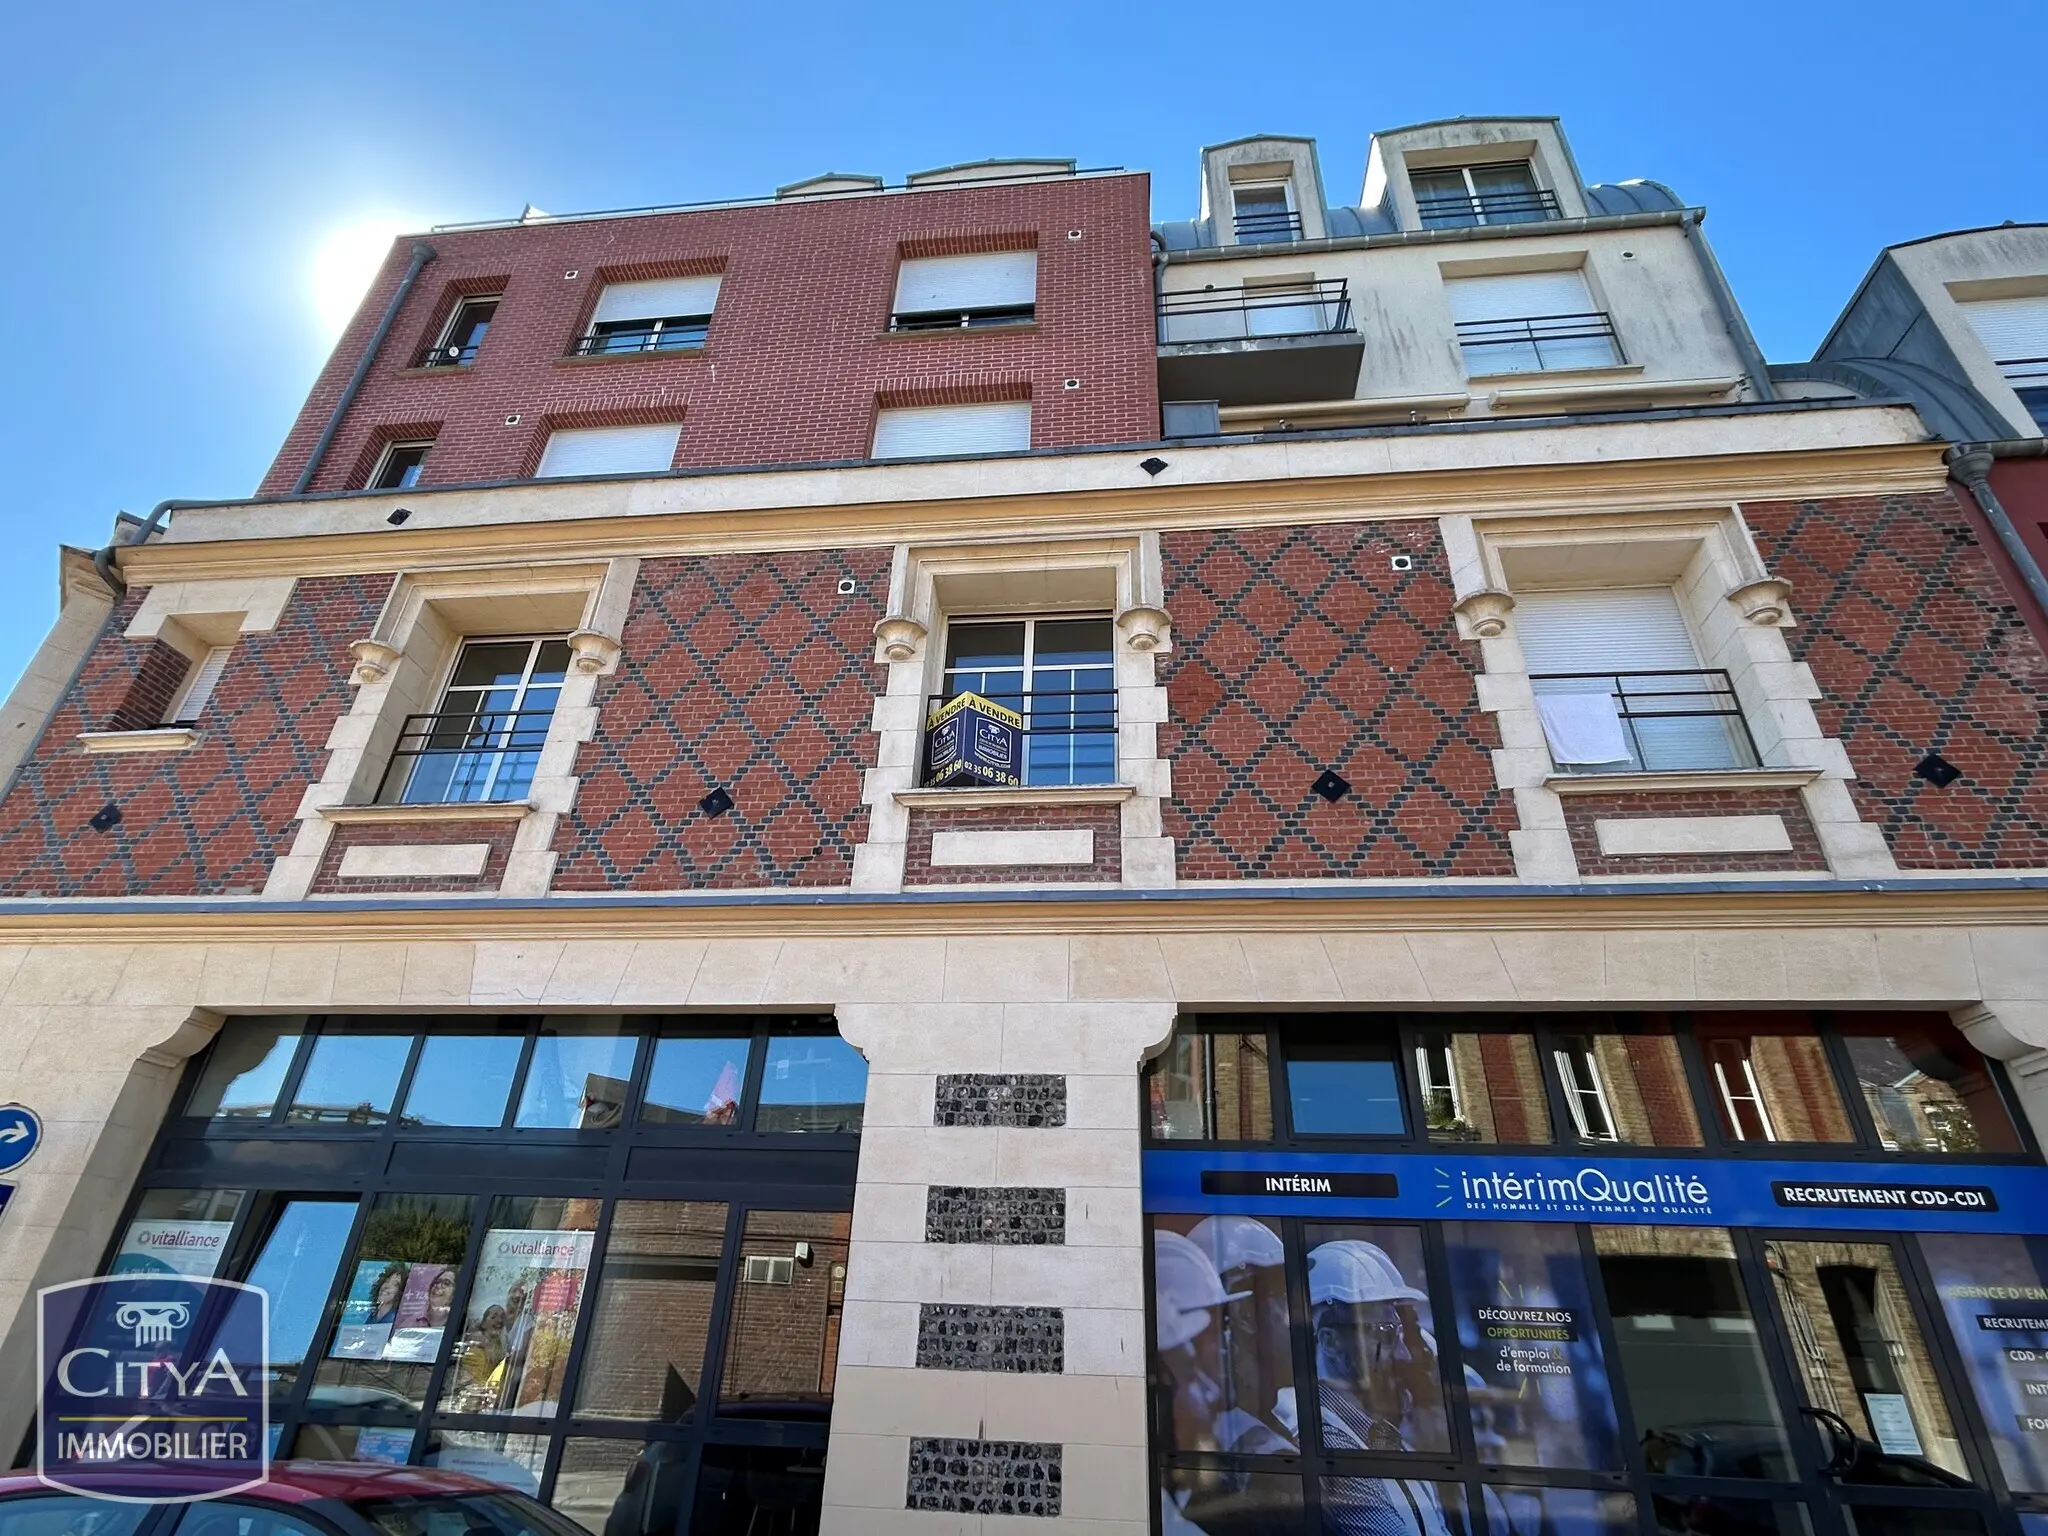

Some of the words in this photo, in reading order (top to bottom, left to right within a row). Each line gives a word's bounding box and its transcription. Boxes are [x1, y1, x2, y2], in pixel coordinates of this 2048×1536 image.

[935, 697, 966, 723] VENDRE
[979, 702, 1020, 728] VENDRE
[936, 768, 944, 782] 06
[944, 763, 953, 779] 38
[953, 759, 962, 772] 60
[964, 761, 972, 770] 02
[973, 764, 981, 774] 35
[982, 766, 994, 779] 06
[995, 770, 1006, 783] 38
[1008, 775, 1019, 786] 60
[1265, 1174, 1331, 1193] INTÉRIM
[1461, 1168, 1709, 1204] intérimQualité
[1783, 1187, 1907, 1205] RECRUTEMENT
[1911, 1191, 1986, 1206] CDD-CDI
[1493, 1203, 1540, 1211] HOMMES
[1566, 1204, 1585, 1212] DES
[1592, 1205, 1636, 1213] FEMMES
[1663, 1205, 1712, 1215] QUALITÉ
[152, 1230, 220, 1248] vitalliance
[511, 1240, 575, 1256] vitalliance
[1949, 1286, 2005, 1300] AGENCE
[2008, 1287, 2048, 1300] D'EM
[1478, 1307, 1544, 1322] DÉCOUVREZ
[1546, 1312, 1572, 1323] NOS
[1487, 1327, 1570, 1340] OPPORTUNITÉS
[1500, 1345, 1550, 1361] d'emploi
[2009, 1350, 2035, 1361] CDD
[1496, 1359, 1511, 1372] de
[1513, 1360, 1571, 1374] formation
[2025, 1383, 2048, 1394] INT
